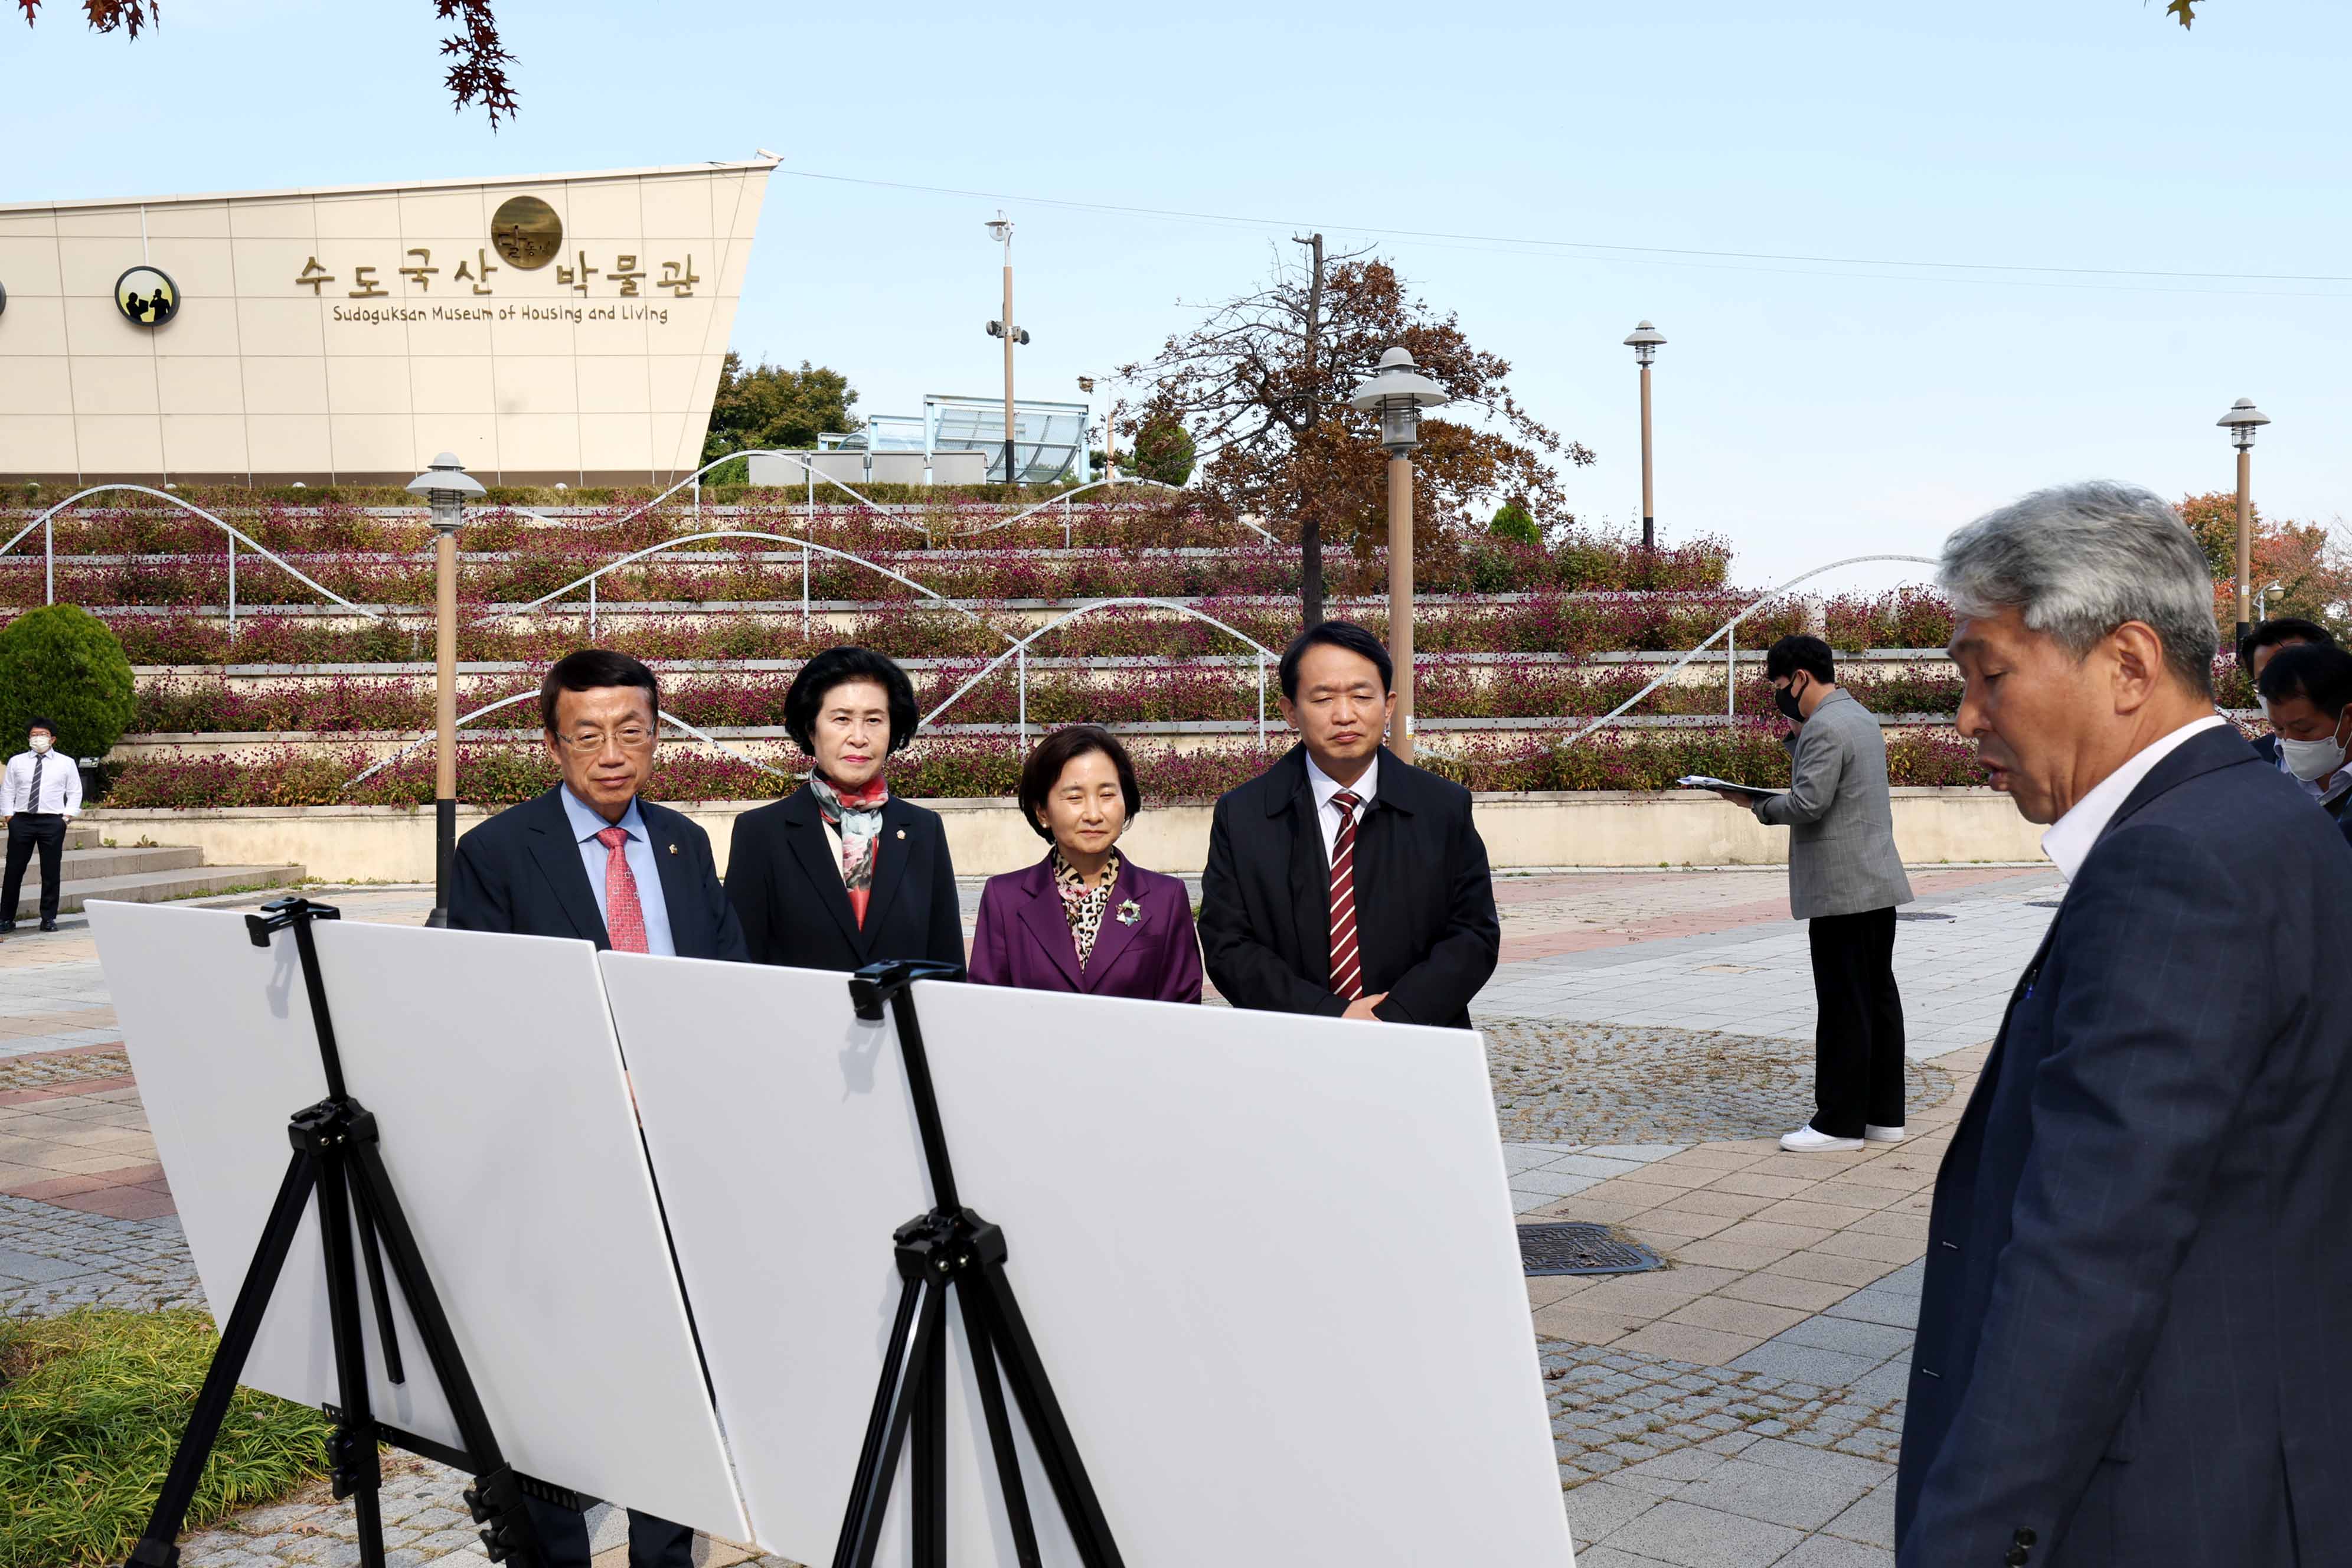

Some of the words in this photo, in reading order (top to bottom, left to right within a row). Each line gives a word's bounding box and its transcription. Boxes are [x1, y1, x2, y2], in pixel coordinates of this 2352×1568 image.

[295, 248, 498, 298] 수도국산
[556, 250, 700, 298] 박물관
[333, 305, 426, 325] Sudoguksan
[432, 305, 493, 321] Museum
[499, 305, 516, 320] of
[522, 304, 583, 324] Housing
[588, 304, 616, 320] and
[622, 304, 668, 324] Living
